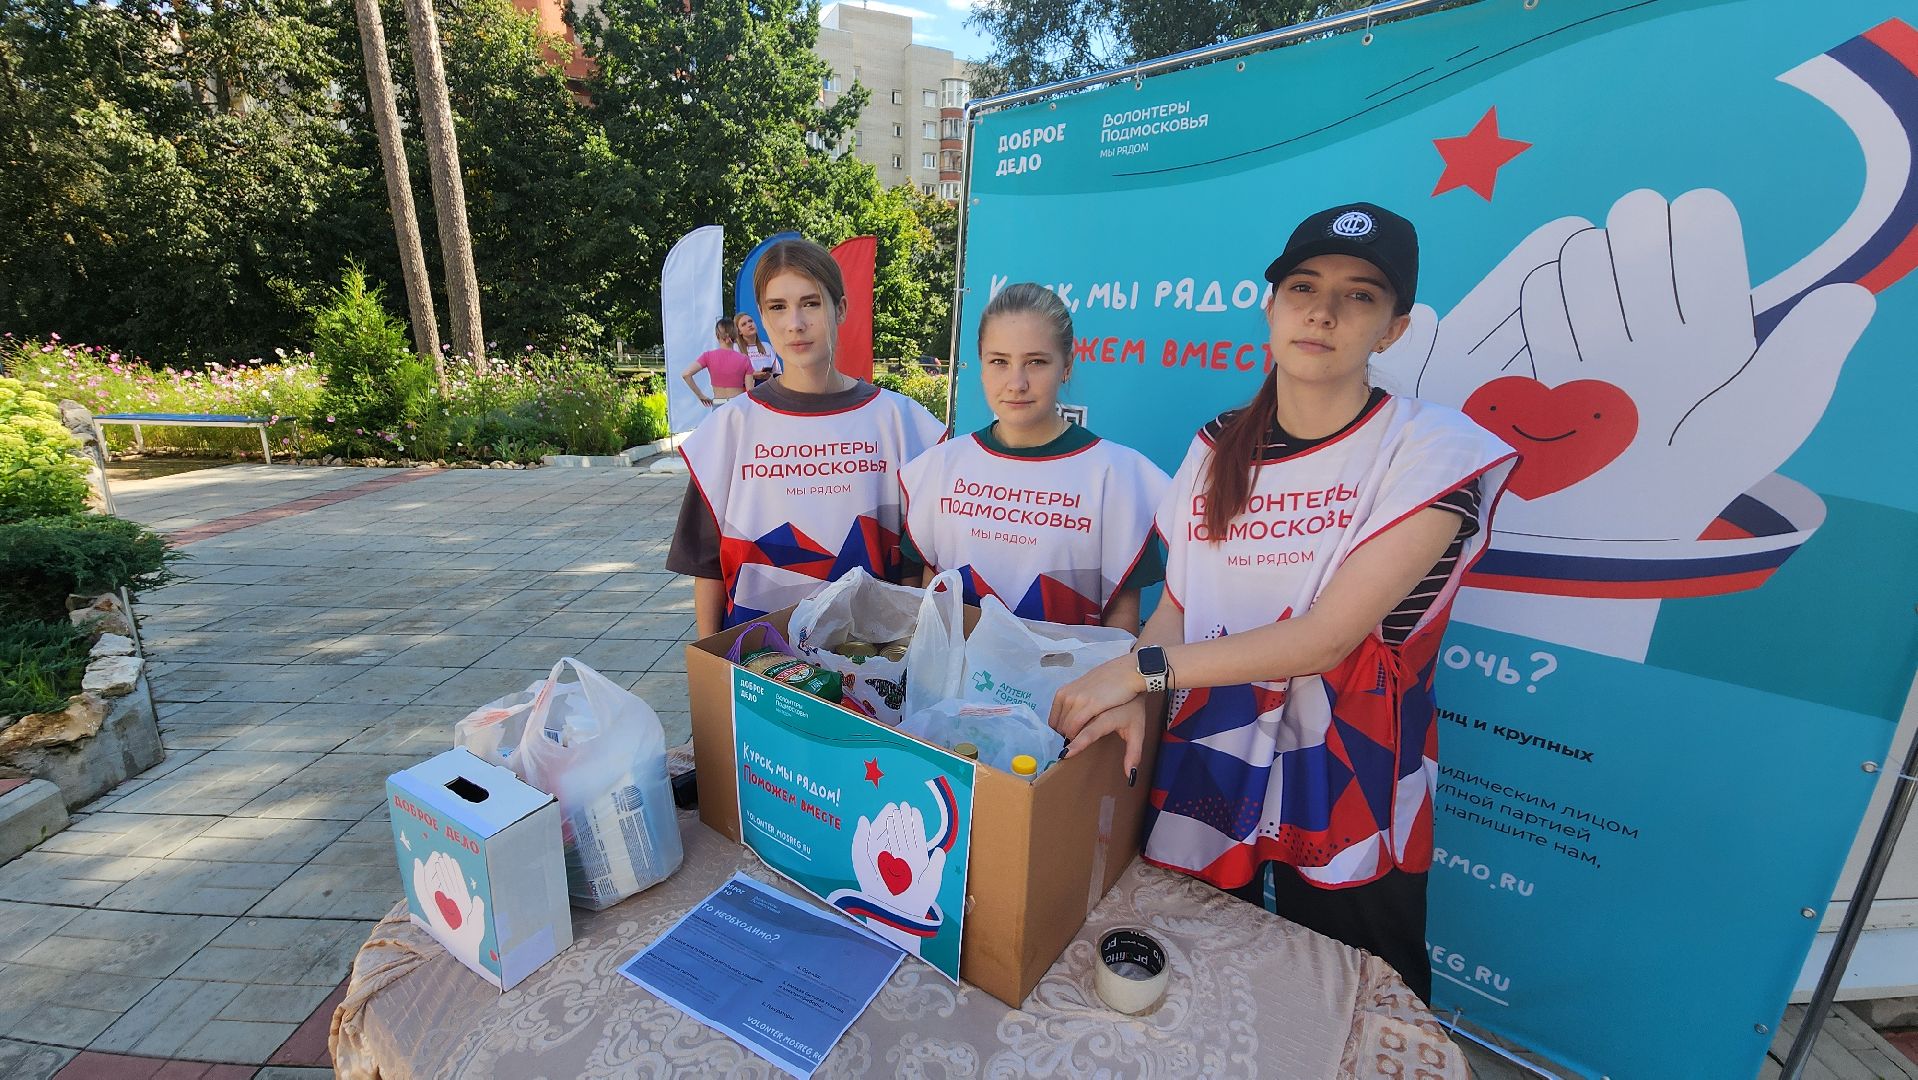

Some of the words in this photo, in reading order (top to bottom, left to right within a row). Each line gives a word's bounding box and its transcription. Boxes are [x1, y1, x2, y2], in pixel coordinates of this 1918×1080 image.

[1100, 114, 1209, 143] ПОДМОСКОВЬЯ
[1102, 100, 1190, 128] ВОЛОНТЕРЫ
[998, 123, 1067, 153] ДОБРОЕ
[1099, 148, 1115, 158] МЫ
[1116, 142, 1149, 156] РЯДОМ
[996, 153, 1042, 177] ДЕЛО
[1161, 339, 1276, 375] ВМЕСТ
[755, 441, 878, 459] ВОЛОНТЕРЫ
[741, 459, 888, 480] ПОДМОСКОВЬЯ
[786, 486, 806, 496] МЫ
[810, 484, 851, 496] РЯДОМ
[953, 478, 1081, 508] ВОЛОНТЕРЫ
[940, 497, 1092, 534] ПОДМОСКОВЬЯ
[971, 528, 991, 540] МЫ
[994, 532, 1038, 546] РЯДОМ
[1227, 555, 1251, 567] МЫ
[1257, 551, 1314, 567] РЯДОМ
[1443, 645, 1558, 694] ОЧЬ?
[740, 679, 765, 695] ДОБРОЕ
[740, 690, 758, 703] ДЕЛО
[999, 682, 1032, 700] АПТЕКИ
[1474, 718, 1487, 731] и
[1493, 725, 1594, 763] крупных
[743, 763, 797, 806] ПОМОЖЕМ
[800, 799, 842, 831] ВМЕСТЕ
[796, 773, 841, 807] РЯДОМ!
[1437, 764, 1556, 811] идическим
[1560, 806, 1639, 840] лицом
[394, 795, 439, 831] ДОБРОЕ
[443, 825, 481, 855] ДЕЛО
[1436, 782, 1494, 811] упной
[1499, 804, 1591, 843] партией
[1444, 805, 1548, 847] напишите
[1554, 842, 1601, 869] нам,
[1433, 847, 1535, 897] RMO.RU
[701, 903, 714, 912] ТО
[714, 909, 781, 944] НЕОБХОДИМО?
[1425, 940, 1511, 992] EG.RU
